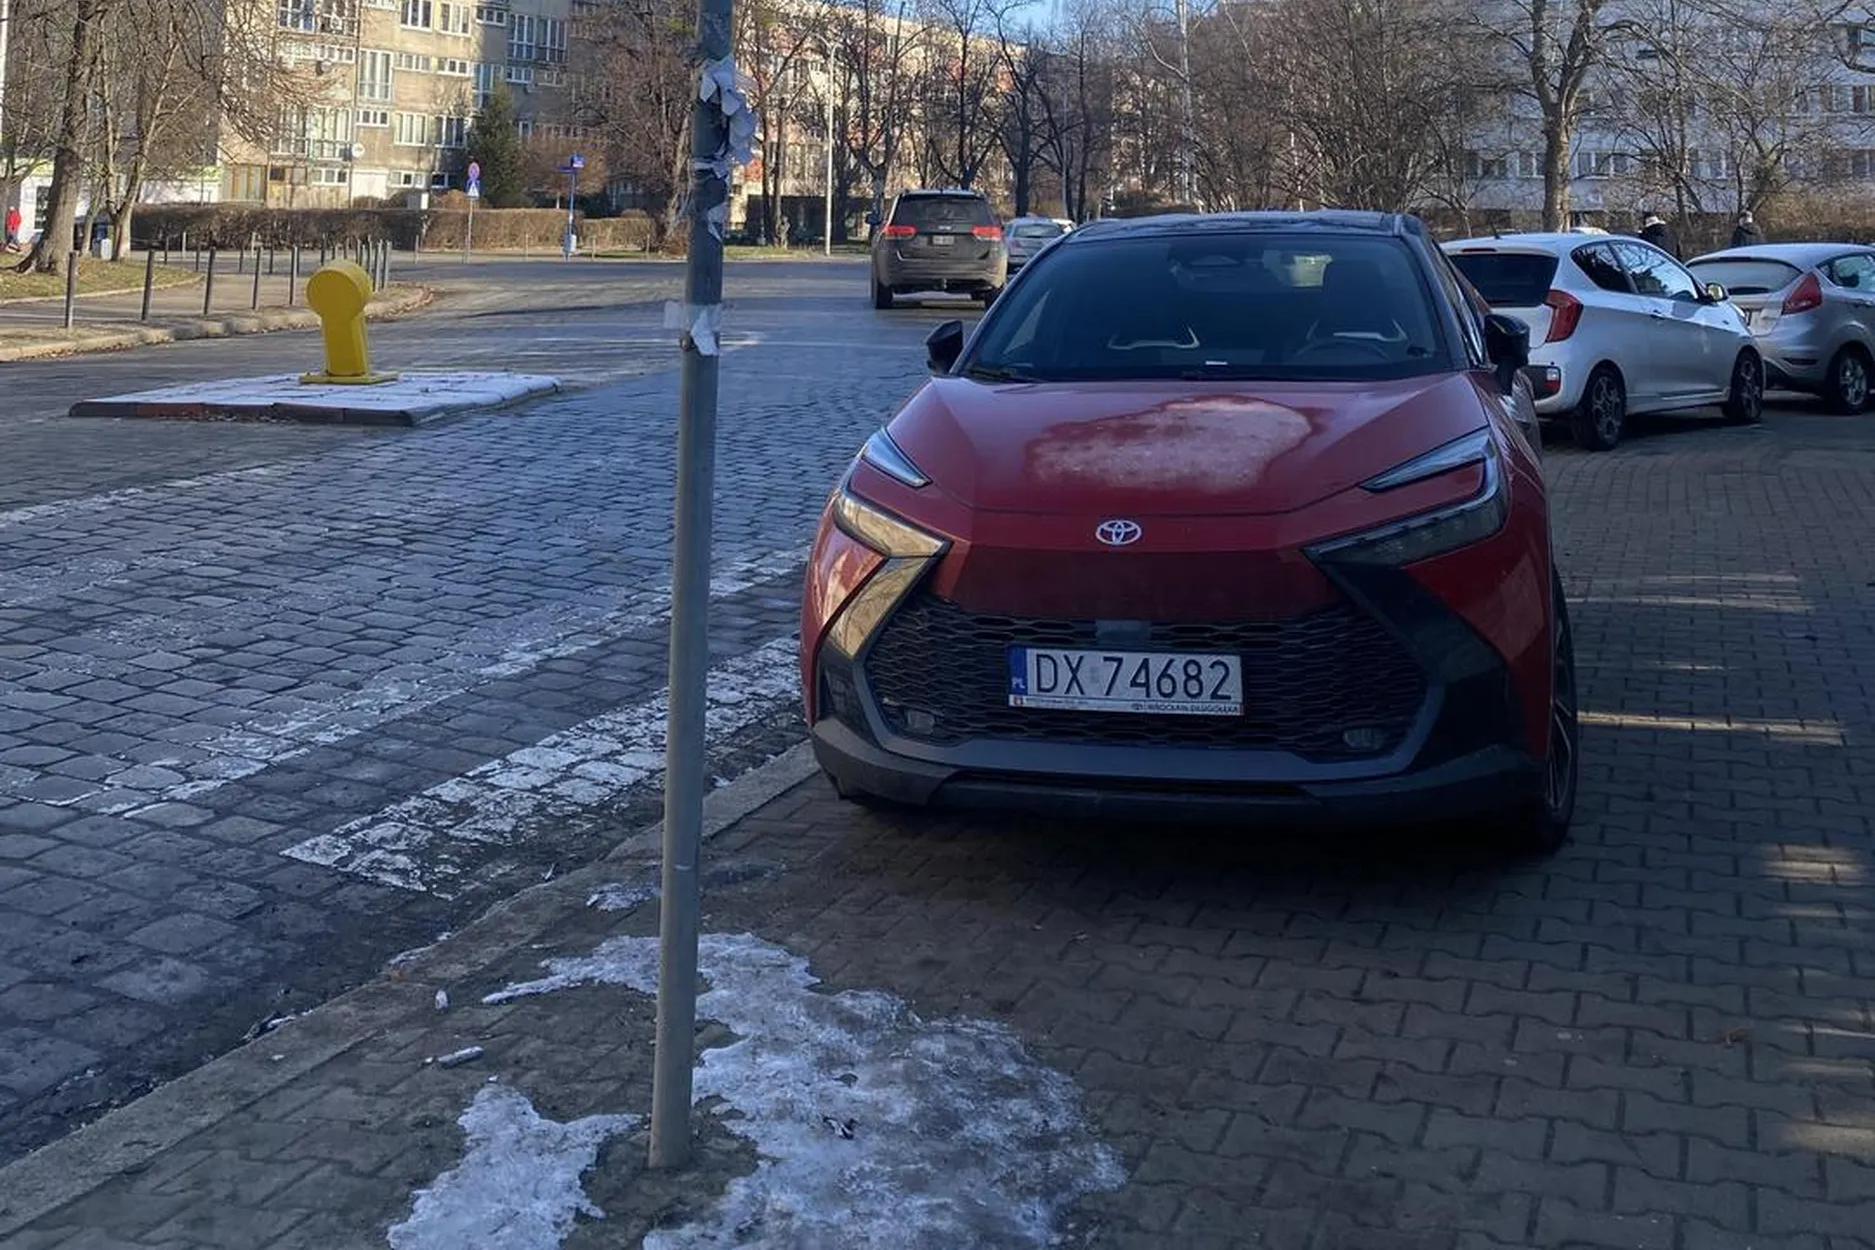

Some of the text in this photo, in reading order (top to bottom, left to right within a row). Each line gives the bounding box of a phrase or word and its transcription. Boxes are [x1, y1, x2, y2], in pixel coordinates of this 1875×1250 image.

[1012, 676, 1026, 689] PL
[1036, 654, 1231, 700] DX 74682
